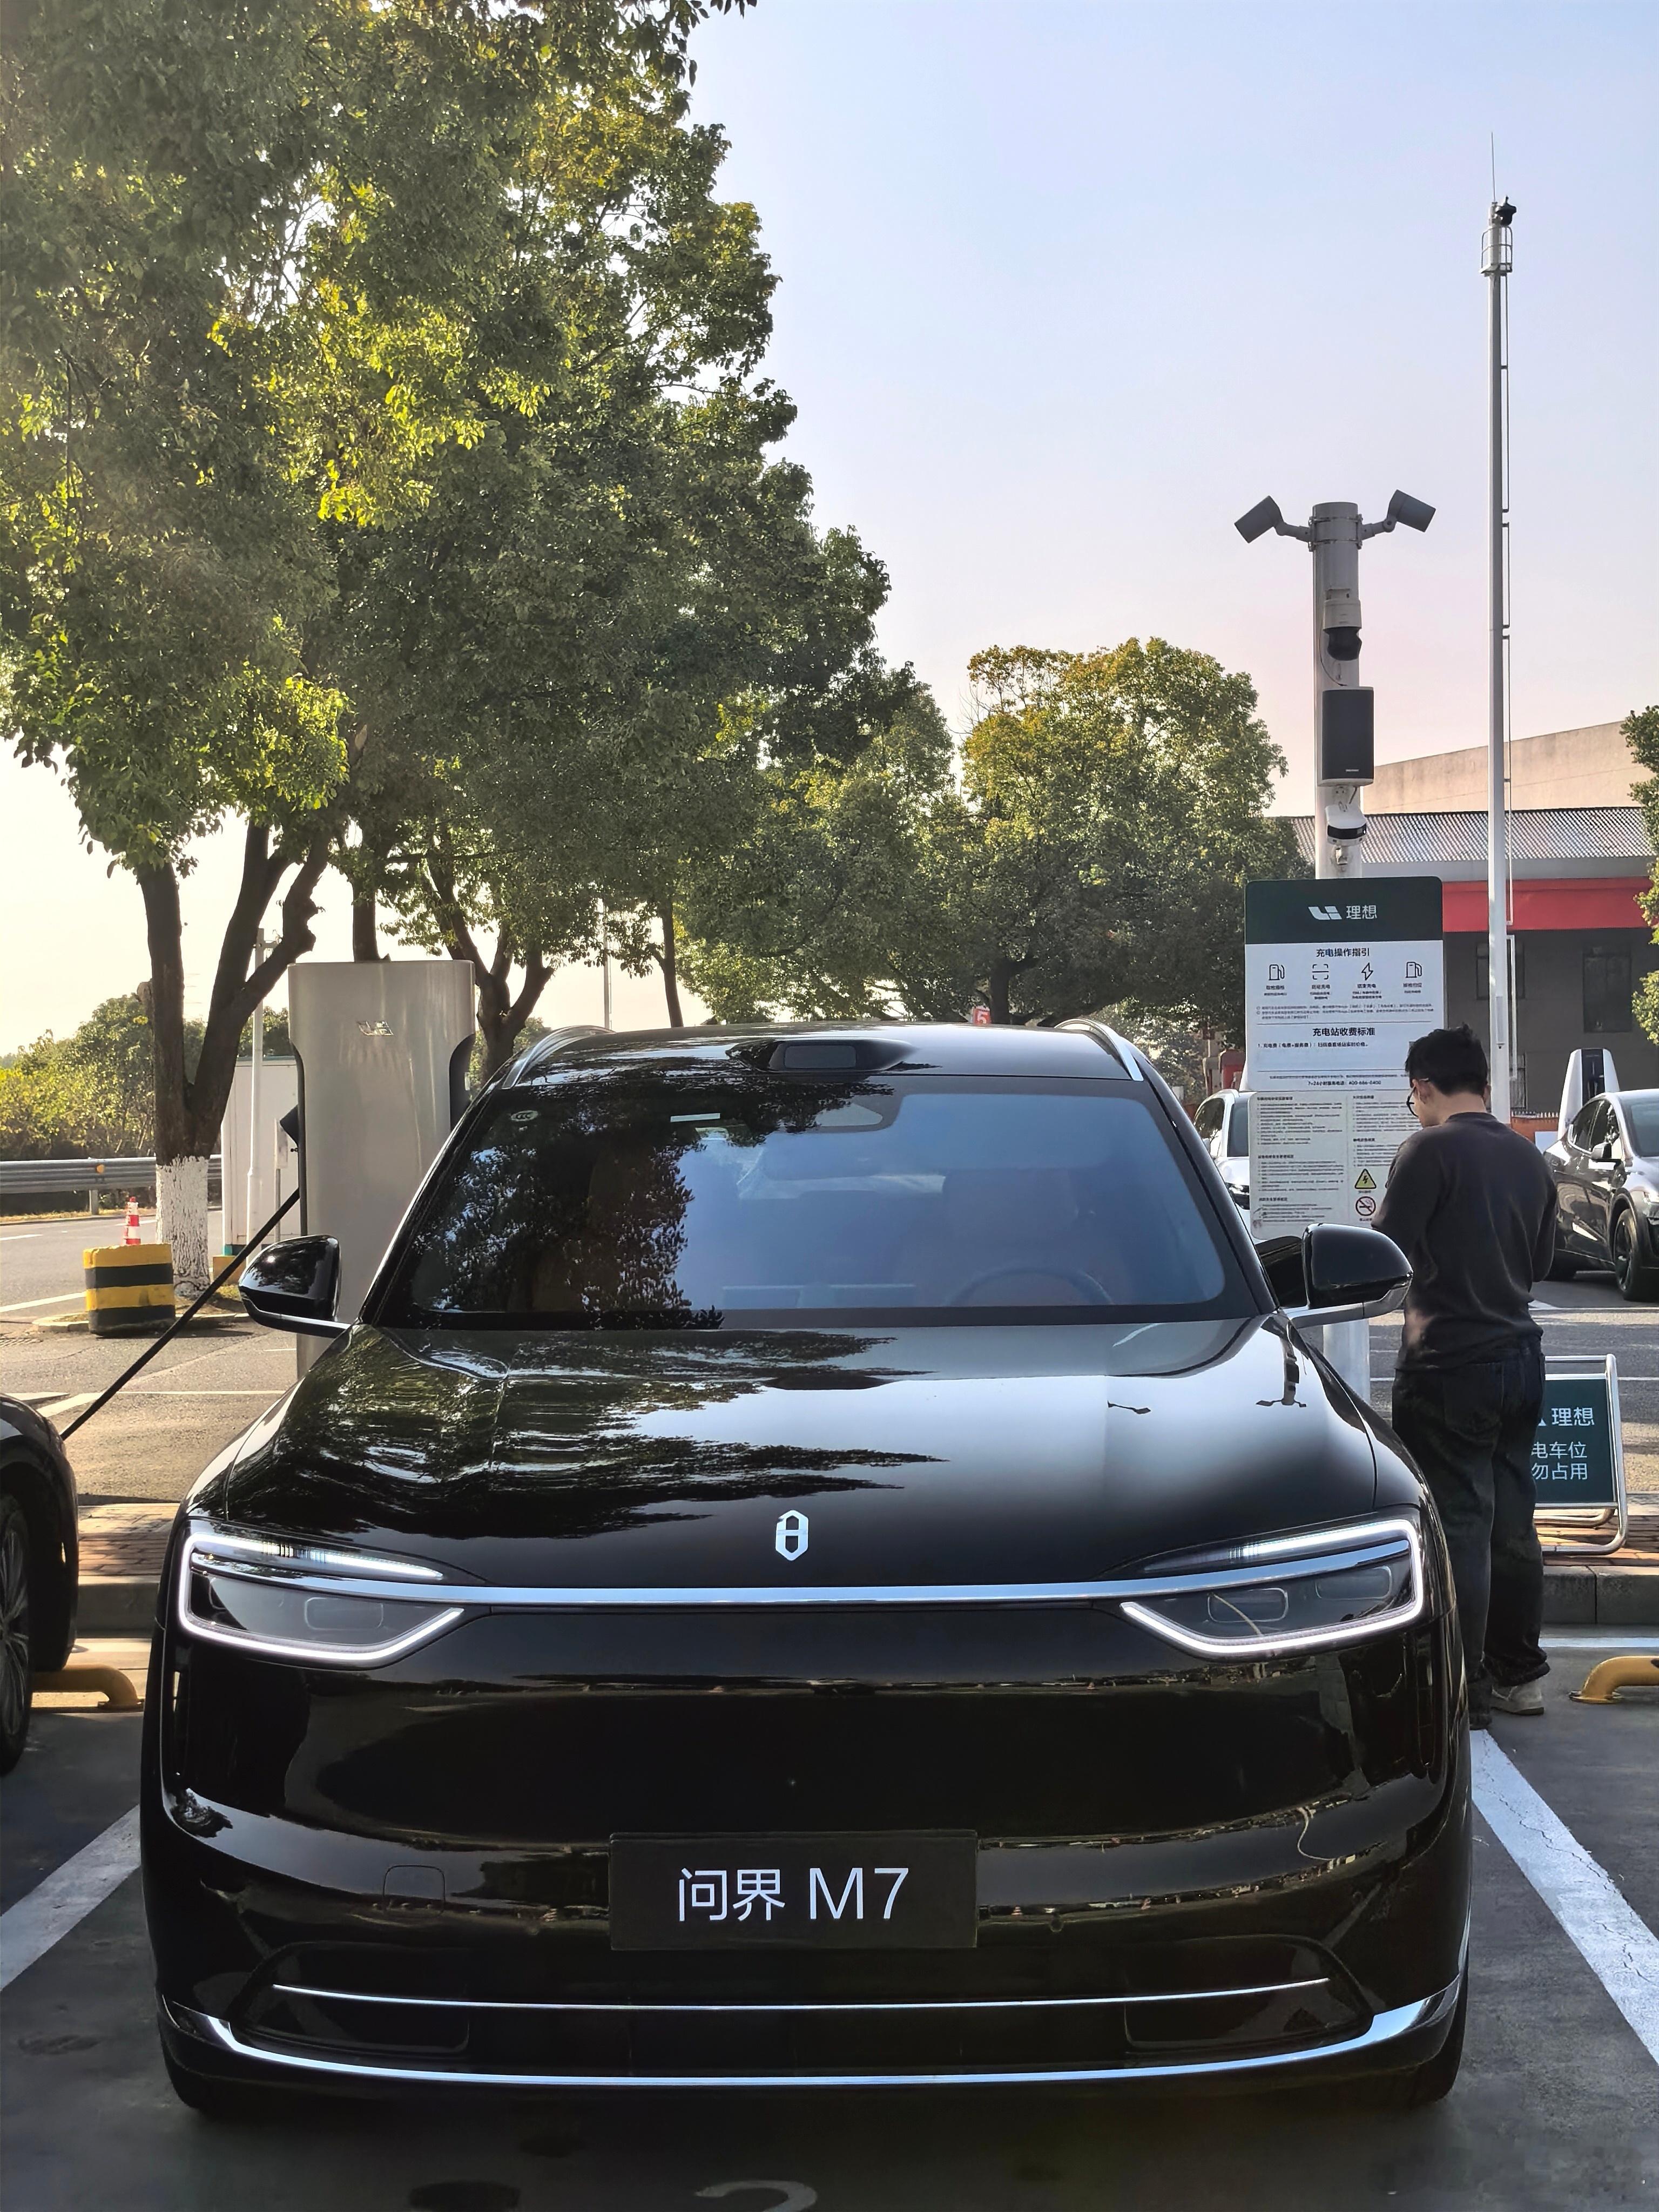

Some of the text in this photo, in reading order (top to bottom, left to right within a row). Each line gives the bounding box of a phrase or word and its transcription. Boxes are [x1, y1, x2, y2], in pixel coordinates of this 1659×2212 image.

[1346, 905, 1377, 920] 理想
[1316, 947, 1370, 957] 充电操作指引
[1312, 1027, 1375, 1037] 充电站收费标准
[1551, 1407, 1595, 1426] 理想
[1531, 1441, 1588, 1459] 电车位
[1532, 1462, 1588, 1480] 勿占用
[678, 1867, 909, 1923] 问界 M7
